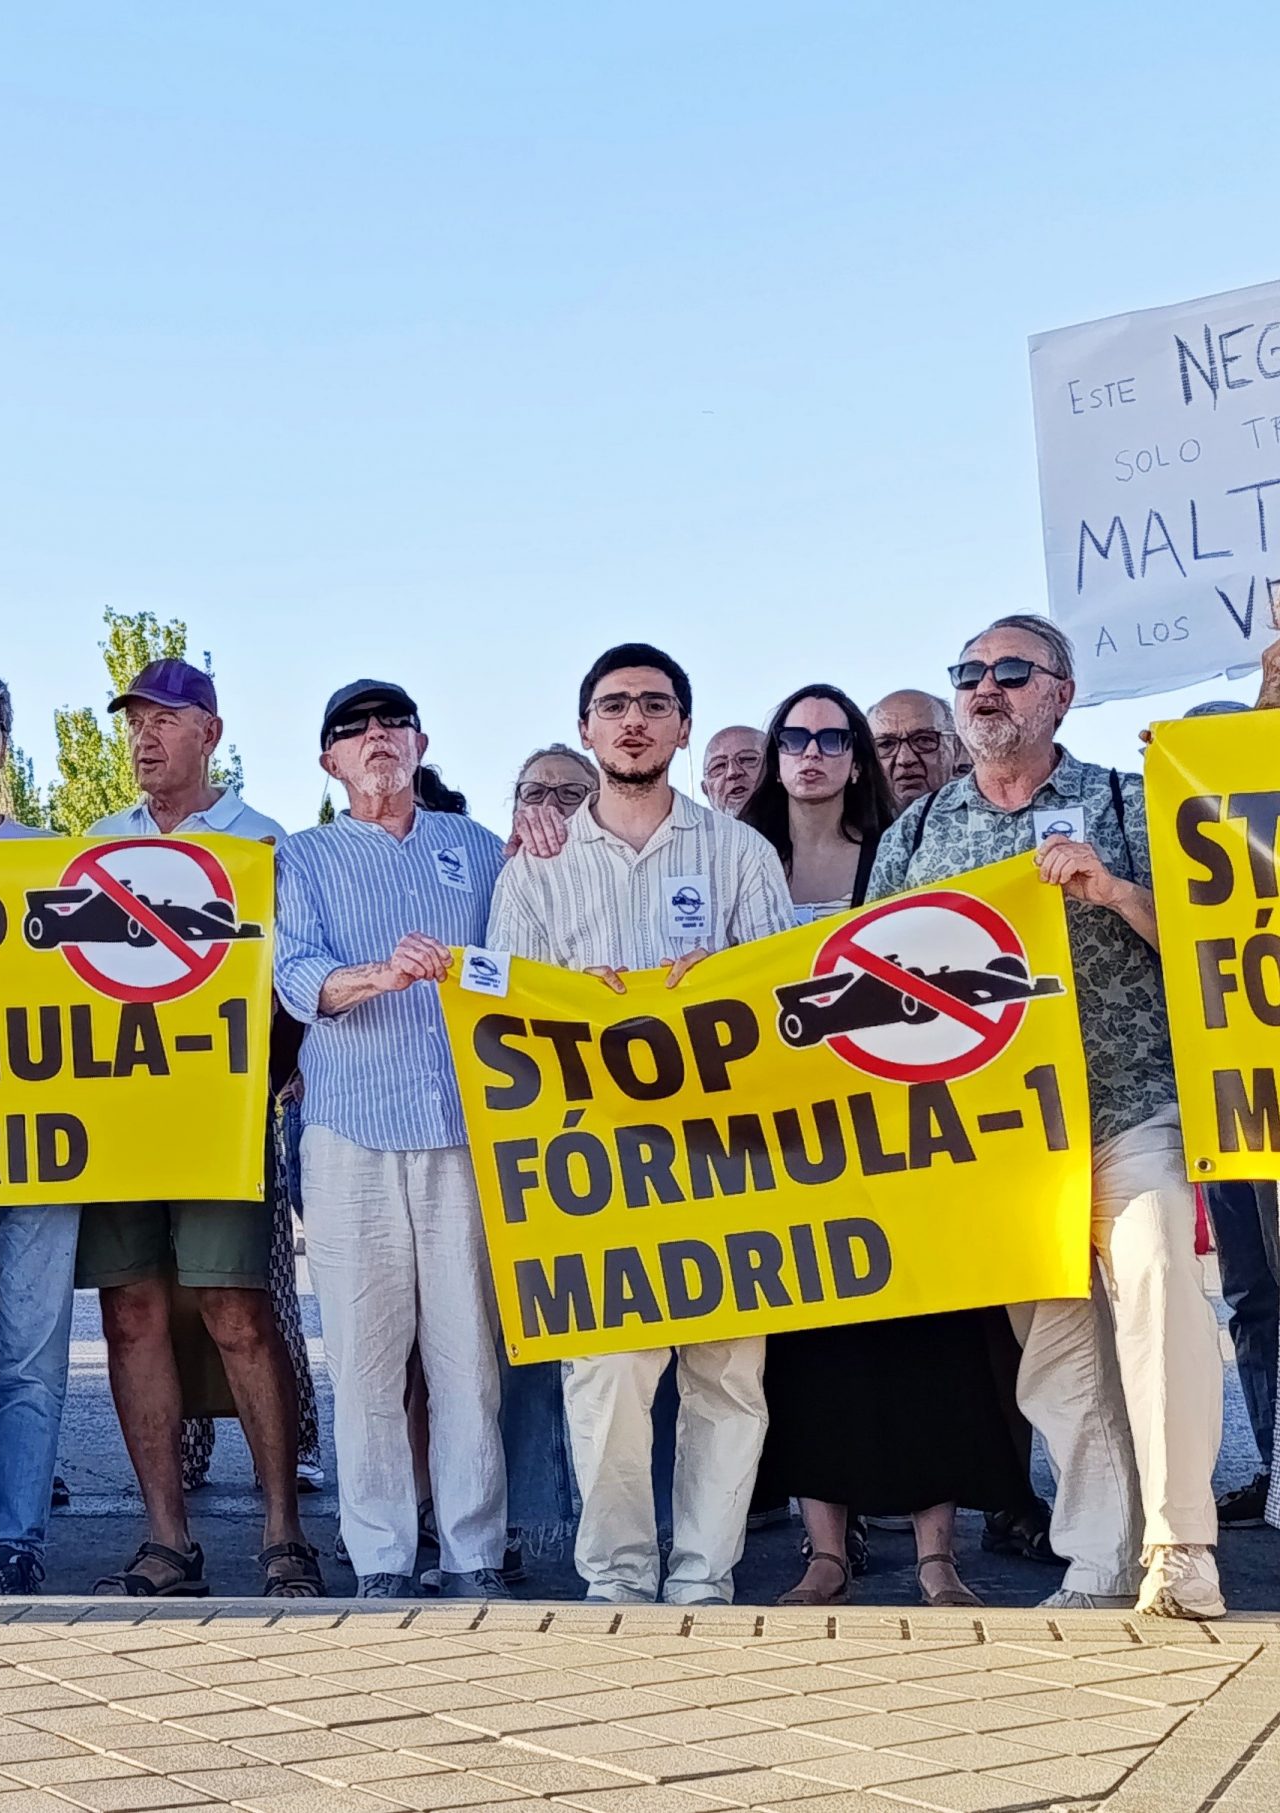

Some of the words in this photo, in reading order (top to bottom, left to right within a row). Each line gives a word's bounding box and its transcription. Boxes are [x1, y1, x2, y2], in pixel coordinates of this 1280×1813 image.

[1068, 377, 1136, 414] ESTE
[1115, 438, 1201, 483] SOLO
[1094, 626, 1118, 657] A
[1136, 616, 1191, 648] LOS
[472, 997, 761, 1111] STOP
[492, 1063, 1070, 1224] FÓRMULA-1
[513, 1216, 893, 1339] MADRID
